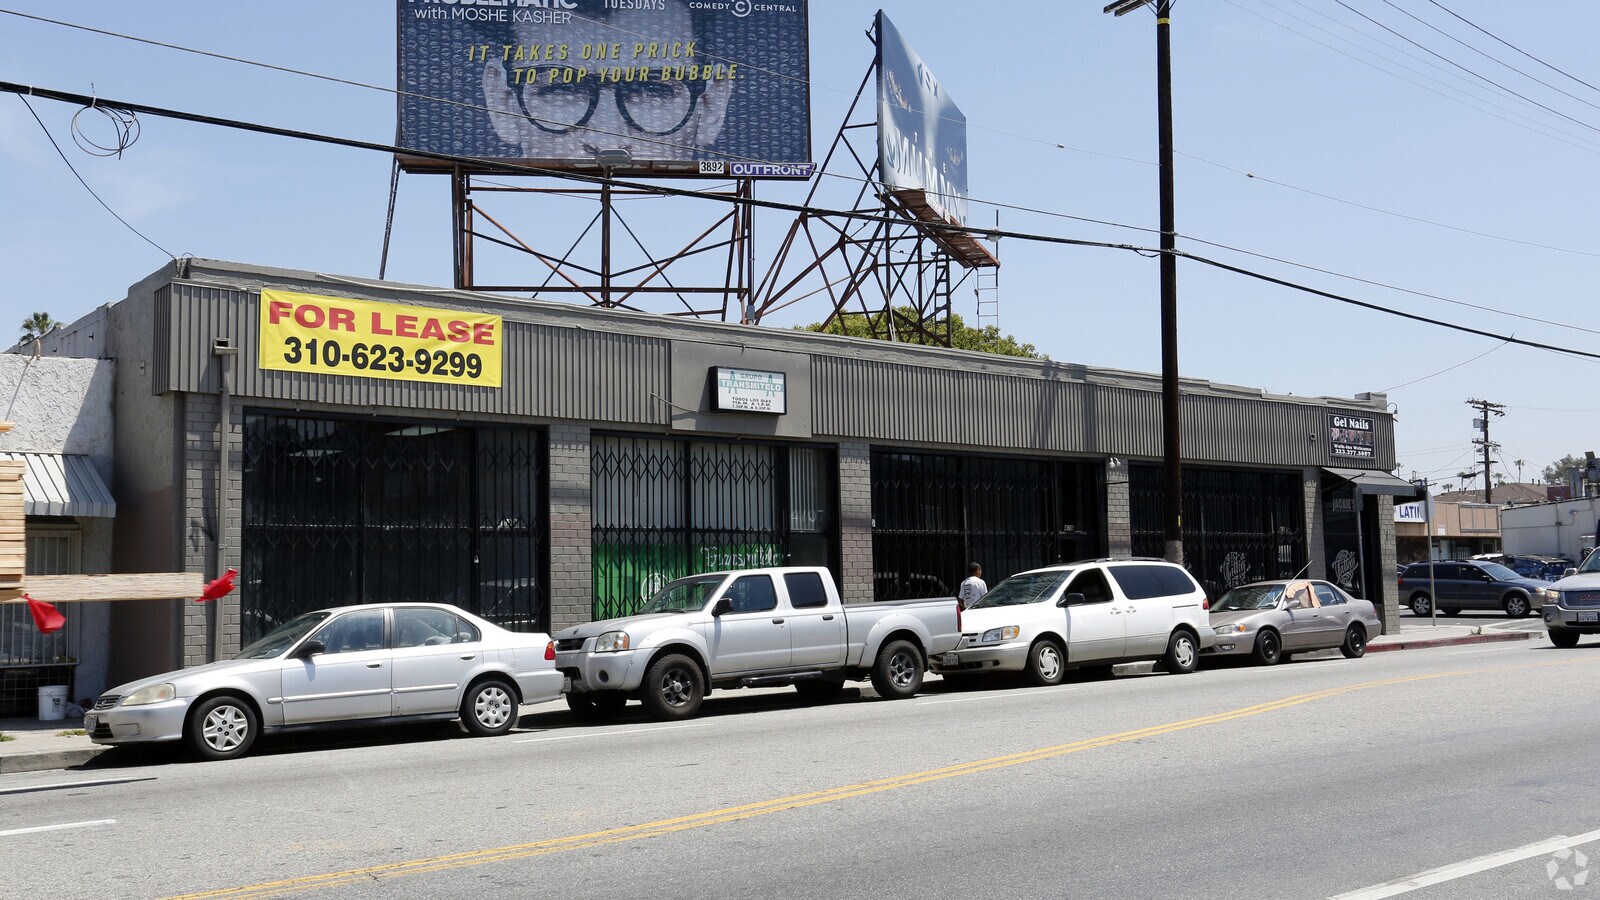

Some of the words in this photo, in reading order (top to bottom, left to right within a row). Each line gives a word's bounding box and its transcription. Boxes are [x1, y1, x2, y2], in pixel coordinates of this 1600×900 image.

[689, 2, 730, 10] COMEDY
[754, 4, 797, 12] CENTRAL
[414, 6, 447, 20] with
[451, 7, 508, 22] MOSHE
[512, 9, 572, 24] KASHER
[468, 45, 490, 61] IT
[503, 44, 569, 61] TAKES
[581, 42, 622, 60] ONE
[633, 41, 697, 59] PRICK
[514, 68, 538, 85] TO
[549, 67, 589, 84] POP
[600, 66, 650, 83] YOUR
[661, 63, 747, 81] BUBBLE.
[700, 161, 724, 172] 3892
[733, 163, 810, 175] OUTFRONT
[268, 300, 356, 333] FOR
[371, 311, 495, 346] LEASE
[283, 336, 483, 379] 310-623-9299
[720, 379, 781, 391] TRANSMITELO
[1334, 416, 1347, 428] Gel
[1349, 418, 1369, 430] Nails
[1399, 505, 1423, 519] LATI
